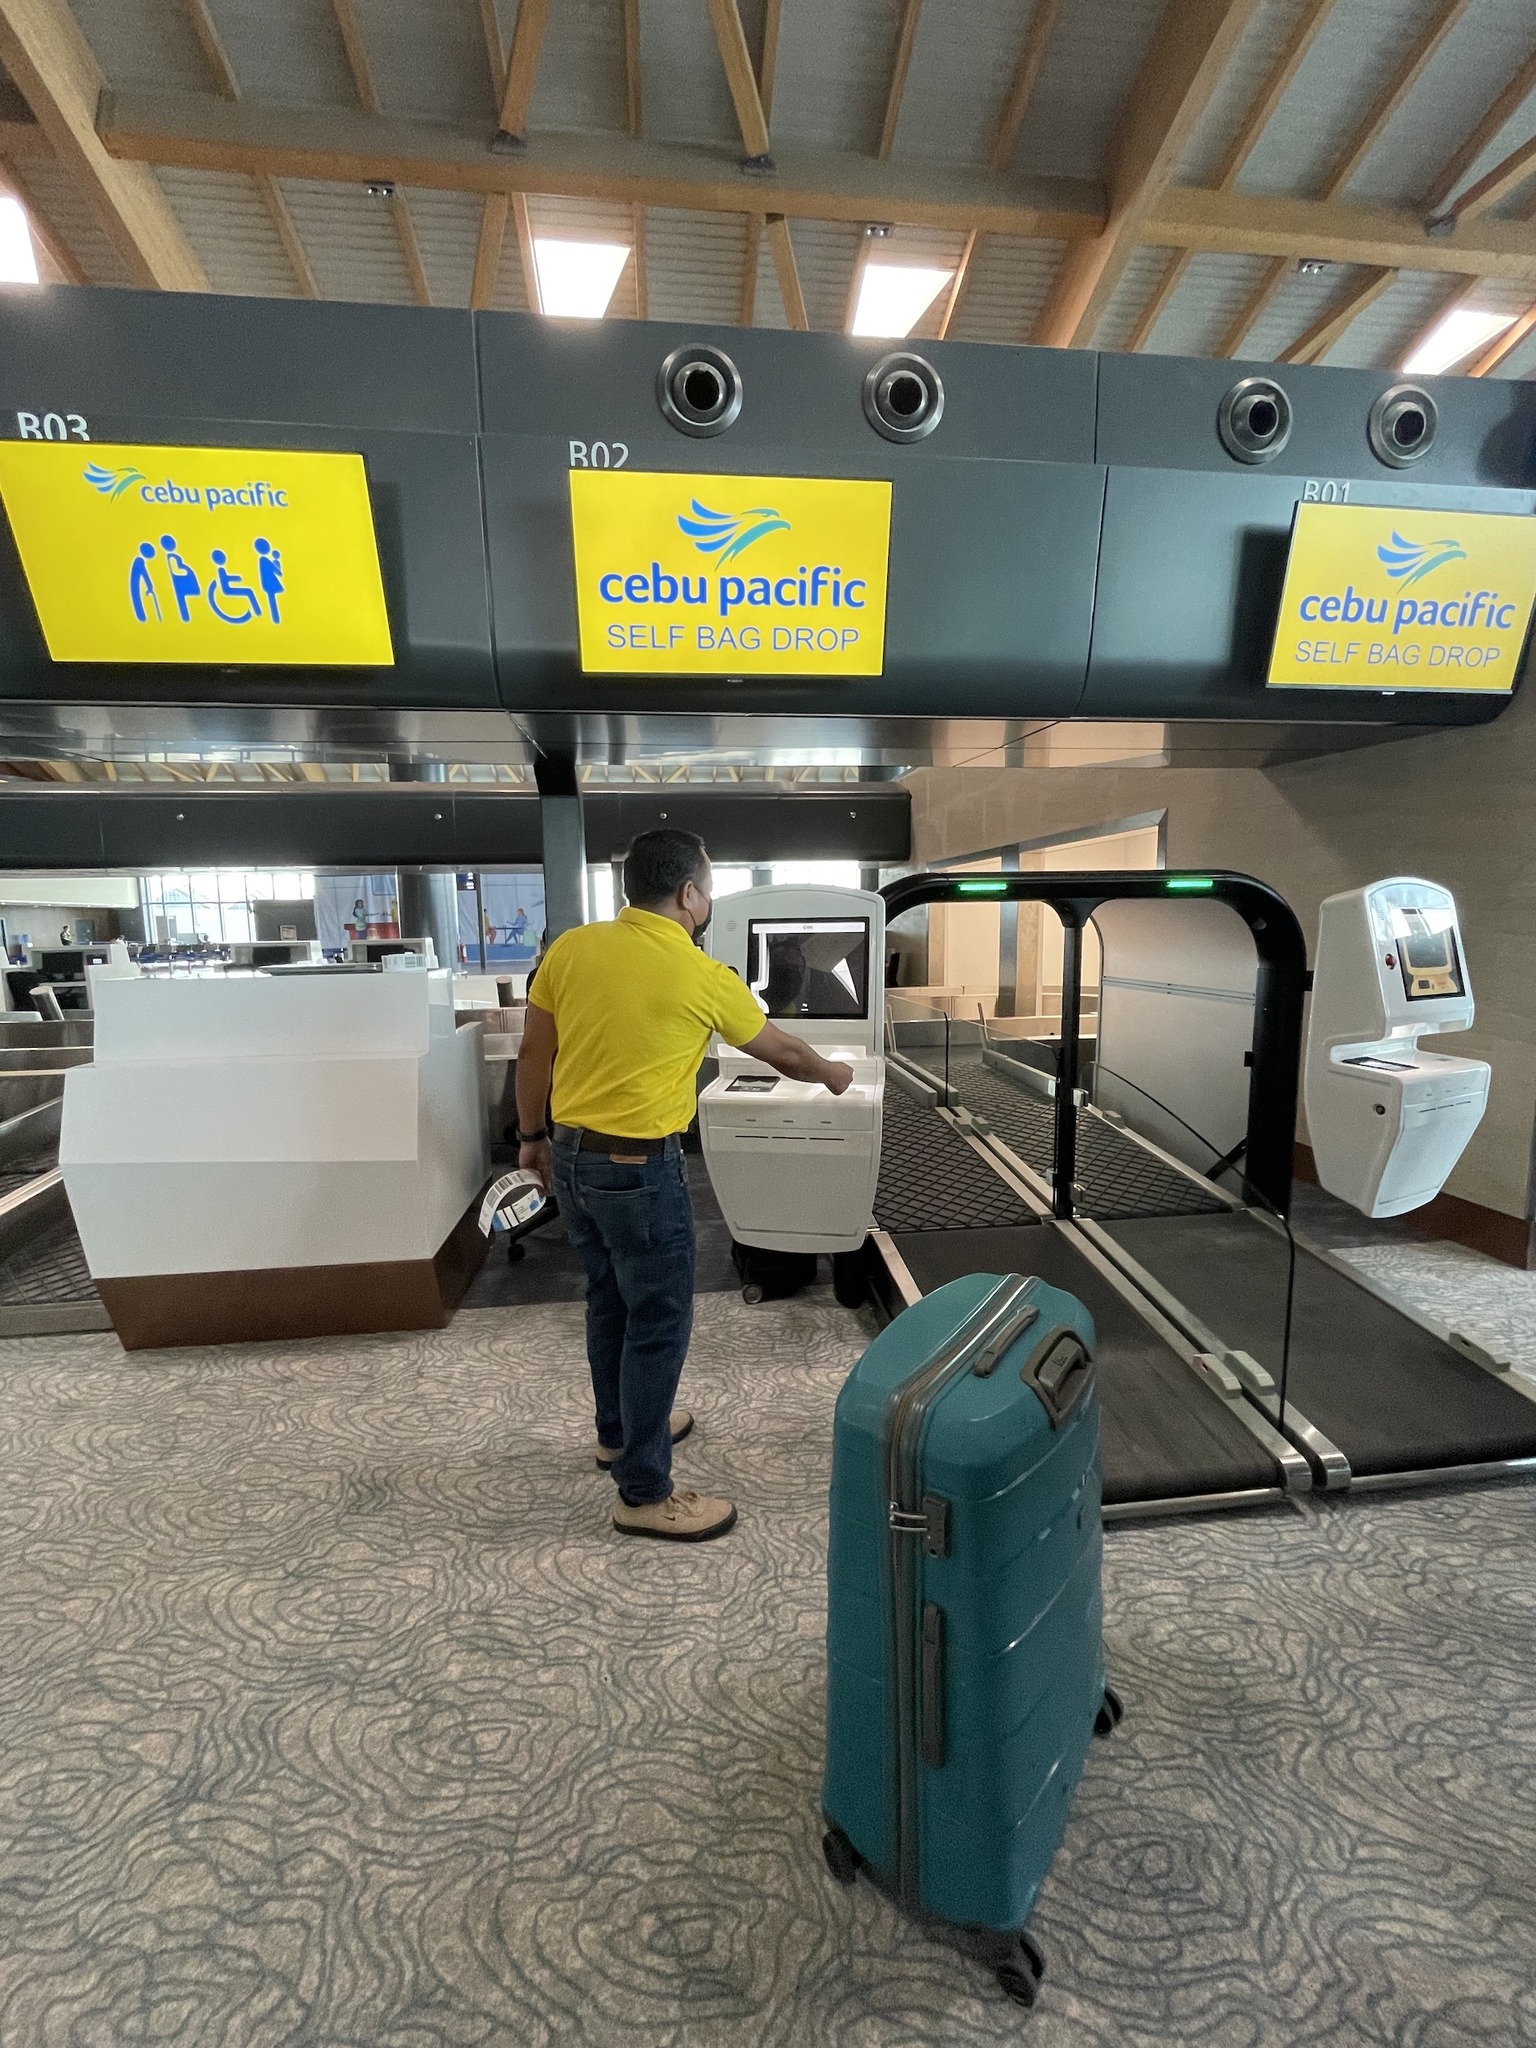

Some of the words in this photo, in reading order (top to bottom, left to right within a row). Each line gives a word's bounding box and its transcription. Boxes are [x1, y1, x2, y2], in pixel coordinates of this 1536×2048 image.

[17, 412, 90, 441] B03
[569, 440, 629, 468] B02
[140, 479, 200, 505] cebu
[206, 481, 289, 511] pacific
[1303, 480, 1350, 502] B01
[600, 562, 707, 604] cebu
[719, 565, 866, 617] pacific
[1299, 586, 1388, 623] cebu
[1392, 591, 1516, 635] pacific
[607, 624, 685, 649] SELF
[697, 626, 761, 650] BAG
[772, 627, 859, 651] DROP
[1295, 641, 1361, 664] SELF
[1367, 643, 1421, 666] BAG
[1428, 645, 1500, 668] DROP
